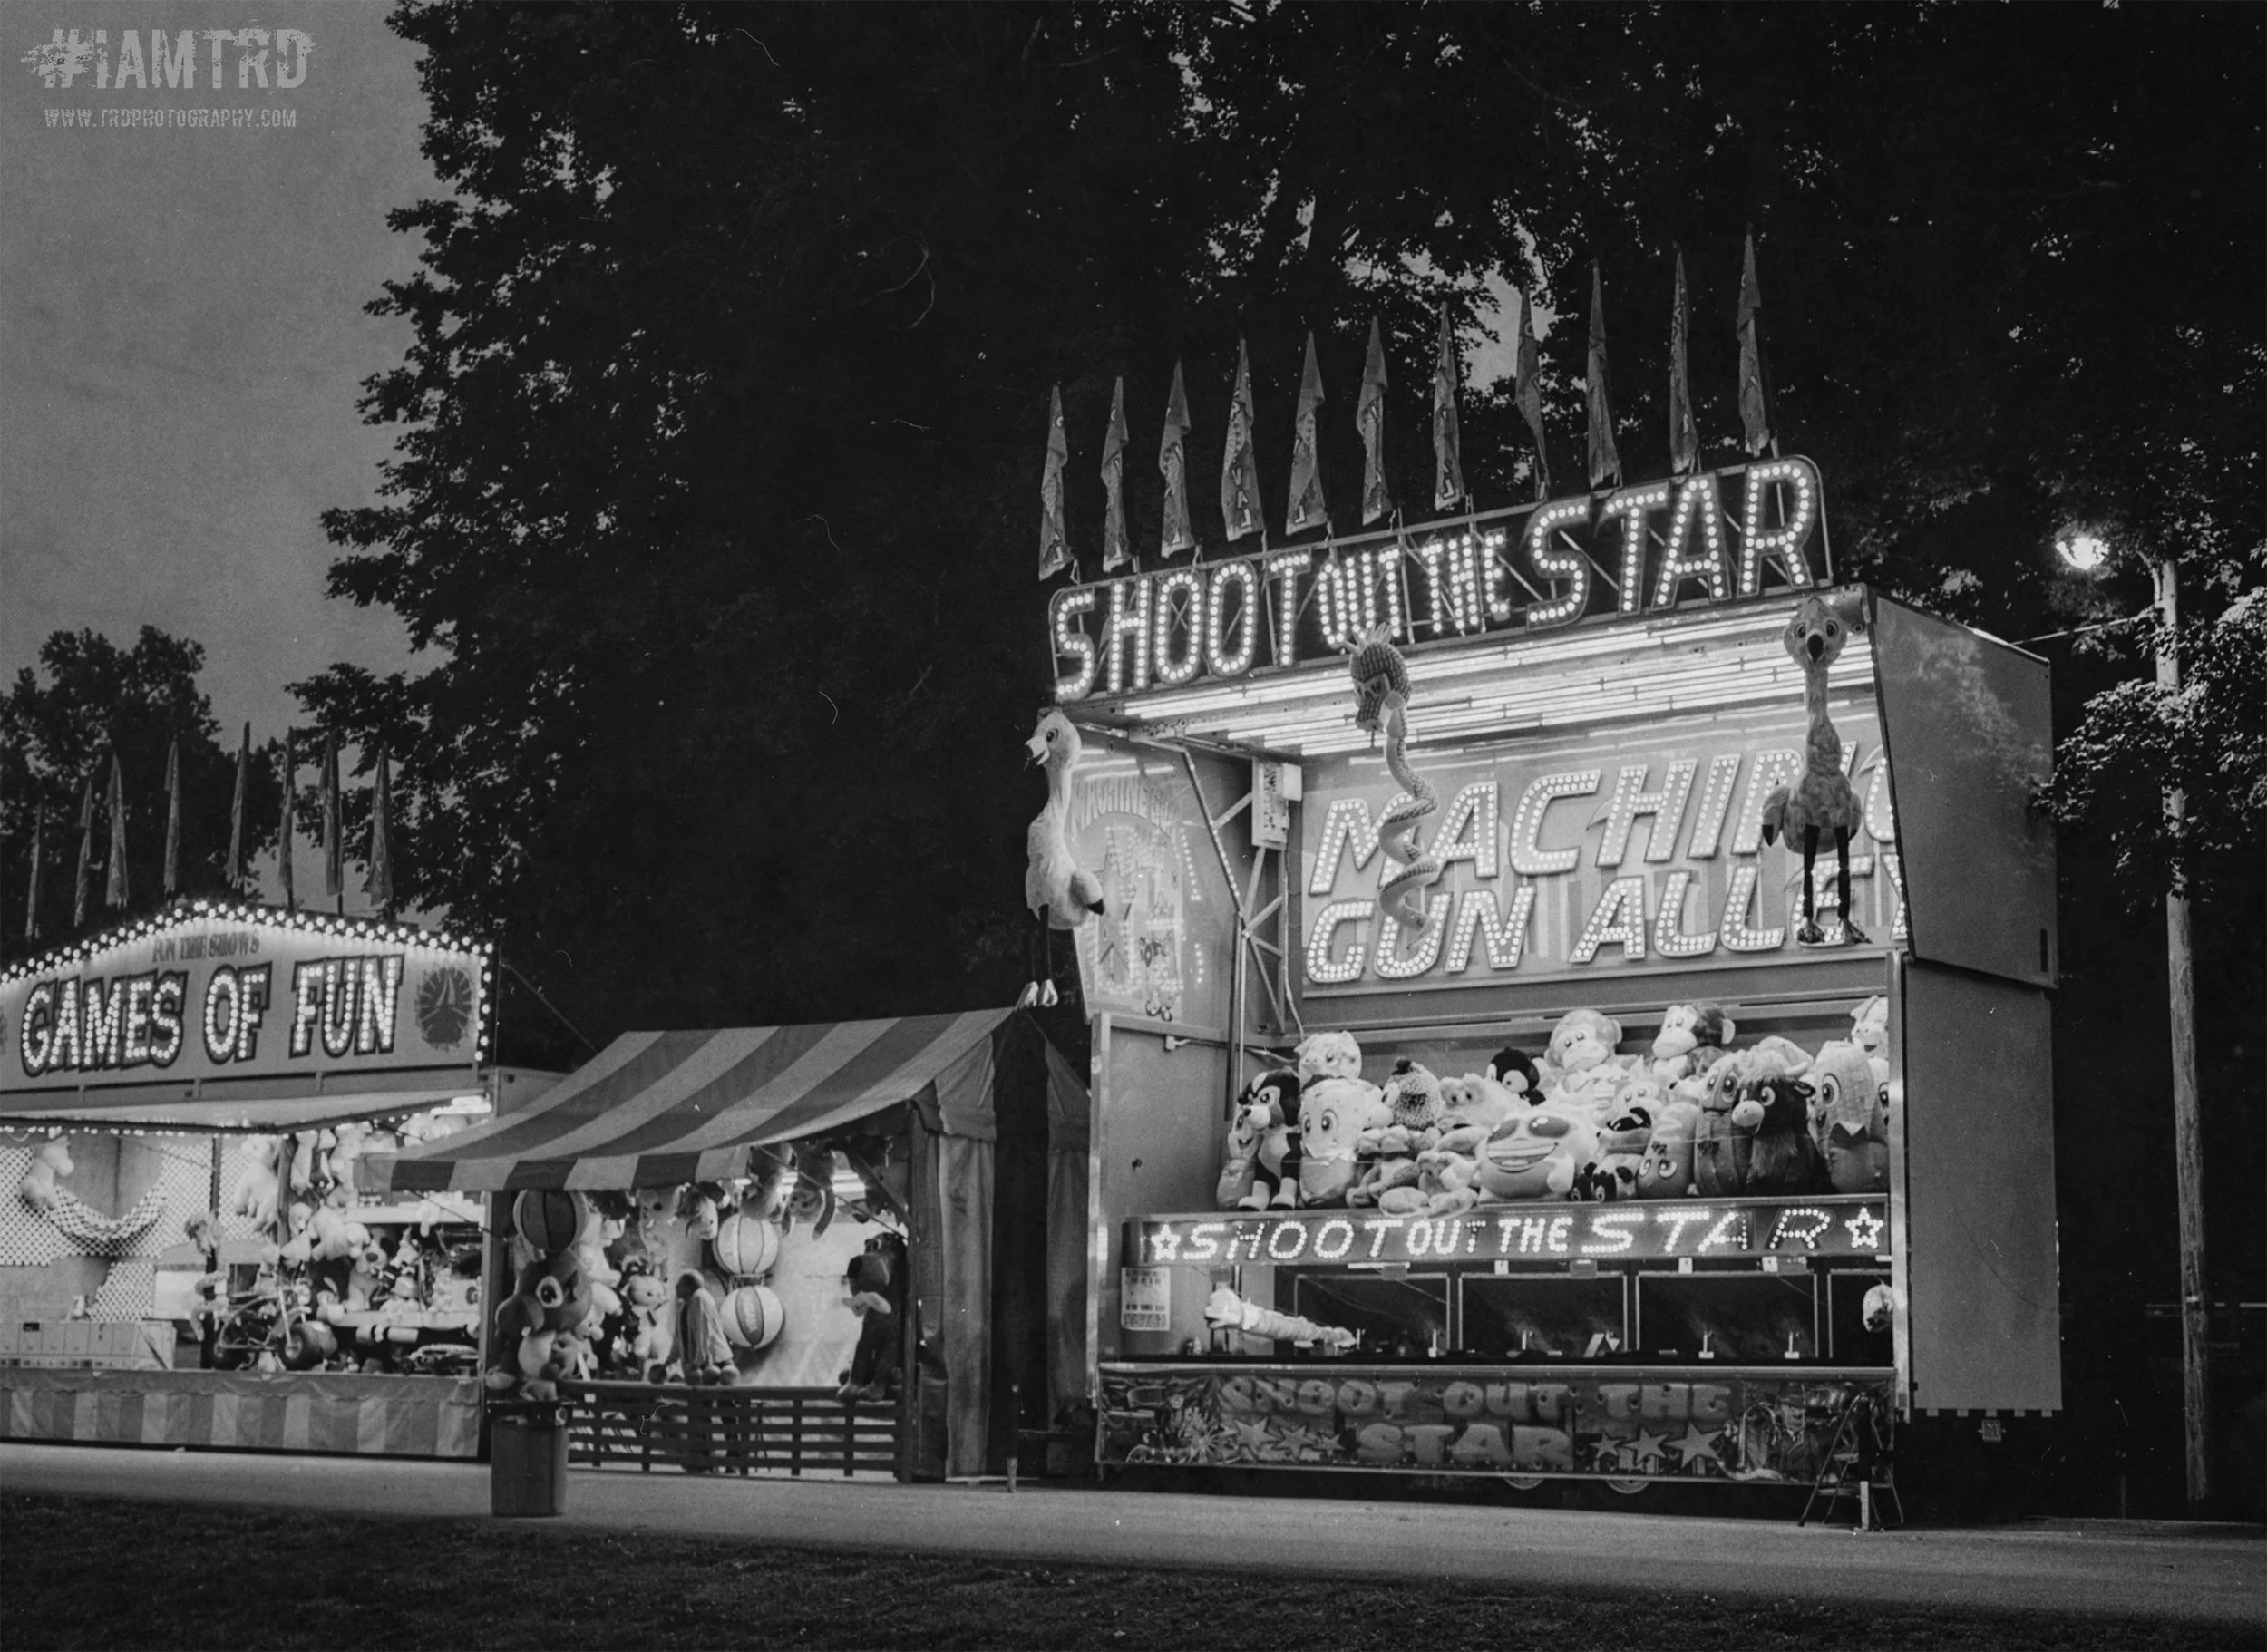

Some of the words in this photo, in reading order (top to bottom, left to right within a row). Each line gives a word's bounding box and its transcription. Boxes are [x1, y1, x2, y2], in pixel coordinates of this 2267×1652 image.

[1052, 547, 1311, 704] SHOOT
[1318, 546, 1400, 649] OUT
[1421, 526, 1511, 634] THE
[1524, 459, 1815, 631] STAR
[1306, 885, 1536, 983] GUN
[21, 968, 188, 1077] GAMES
[203, 961, 272, 1064] OF
[289, 953, 404, 1059] FUN
[1182, 1219, 1404, 1260] SHOOT
[1406, 1219, 1487, 1256] OUT
[1498, 1216, 1573, 1254] THE
[1581, 1207, 1833, 1253] STAR
[1221, 1377, 1417, 1417] SHOOT
[1443, 1380, 1569, 1422] OUT
[1597, 1383, 1730, 1421] THE
[1357, 1422, 1574, 1472] STAR
